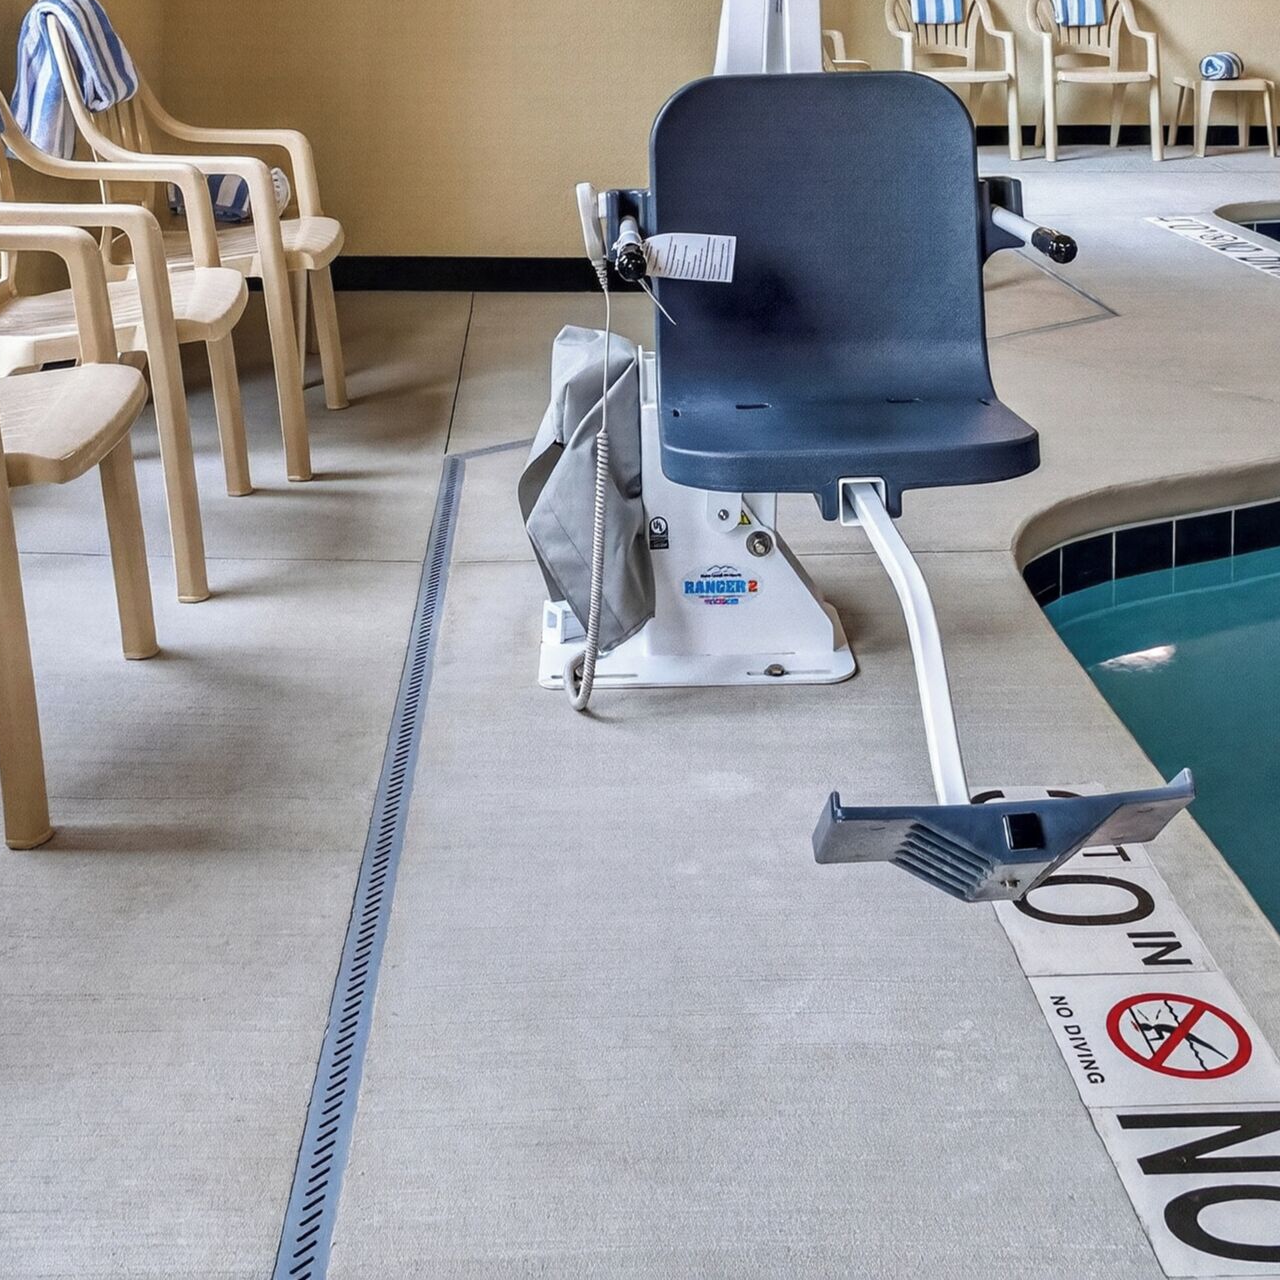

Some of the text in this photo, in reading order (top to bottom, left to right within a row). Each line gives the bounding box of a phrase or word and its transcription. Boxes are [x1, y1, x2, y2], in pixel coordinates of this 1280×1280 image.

[685, 580, 758, 593] RANGER 2
[1127, 931, 1193, 966] IN
[1050, 996, 1105, 1084] NO DIVING
